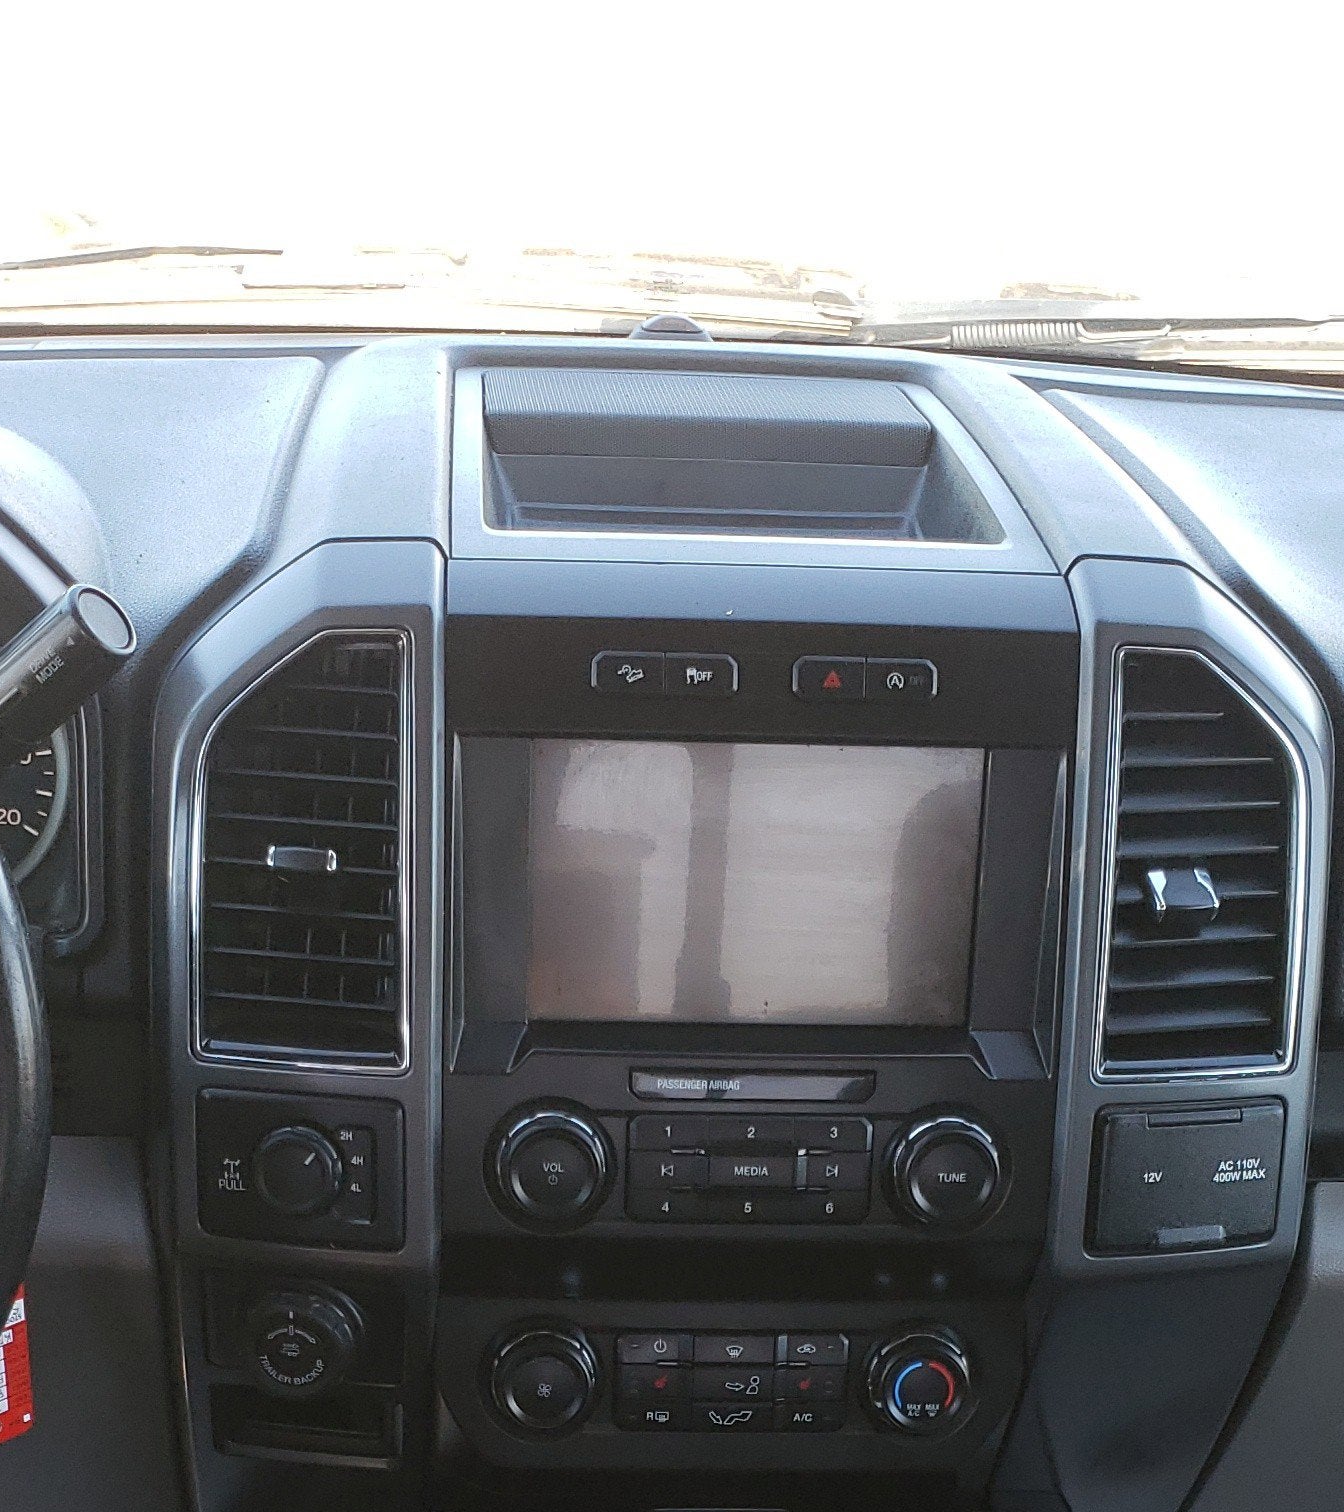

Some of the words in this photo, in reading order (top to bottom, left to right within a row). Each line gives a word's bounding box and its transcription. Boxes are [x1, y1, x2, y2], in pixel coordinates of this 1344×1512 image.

[696, 671, 713, 683] OFF
[656, 1078, 707, 1091] PASSENGER
[709, 1078, 741, 1091] AIRBAG
[339, 1131, 354, 1142] 2H
[664, 1126, 672, 1138] 1
[747, 1126, 756, 1139] 2
[829, 1126, 838, 1139] 3
[351, 1156, 364, 1167] 4H
[542, 1162, 565, 1174] VOL
[1218, 1160, 1235, 1172] AC
[1235, 1158, 1262, 1171] 110V
[734, 1165, 769, 1178] MEDIA
[937, 1172, 968, 1184] TUNE
[1142, 1171, 1163, 1184] 12V
[1212, 1171, 1242, 1184] 400W
[1242, 1168, 1266, 1181] MAX
[218, 1179, 246, 1192] PULL
[351, 1182, 363, 1193] 4L
[661, 1202, 670, 1214] 4
[743, 1202, 752, 1214] 5
[825, 1202, 834, 1215] 6
[258, 1354, 292, 1384] TRAILER
[292, 1359, 325, 1386] BACKUP
[792, 1411, 814, 1424] A/C
